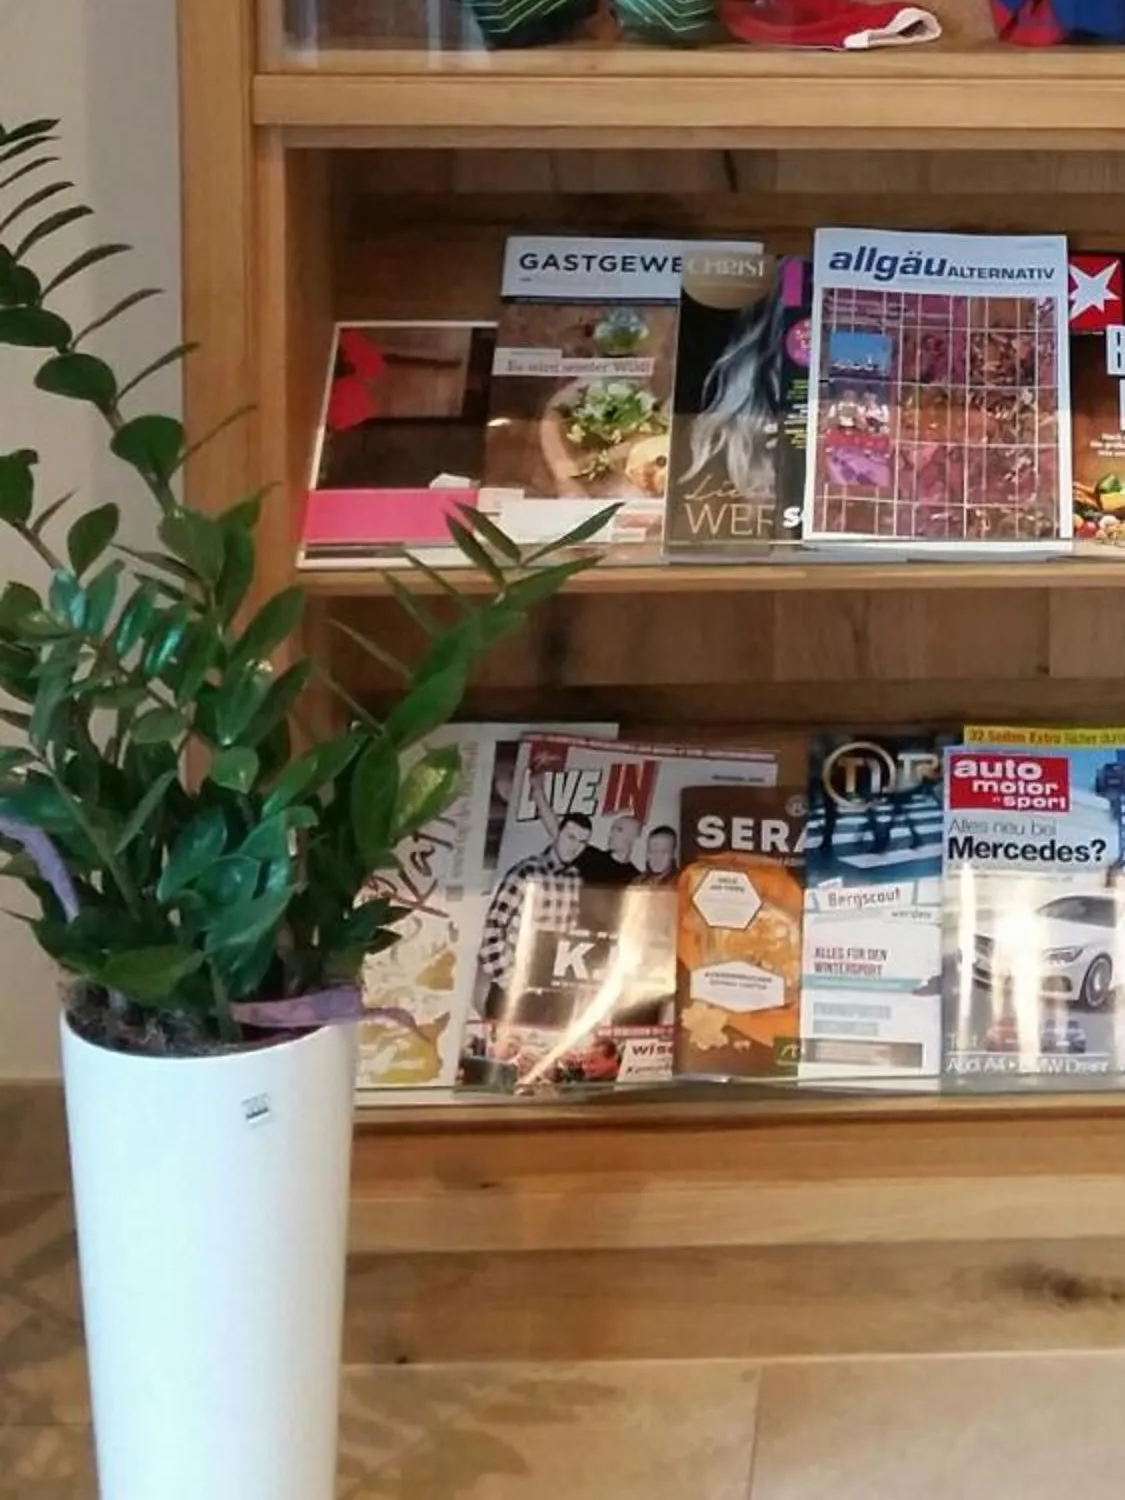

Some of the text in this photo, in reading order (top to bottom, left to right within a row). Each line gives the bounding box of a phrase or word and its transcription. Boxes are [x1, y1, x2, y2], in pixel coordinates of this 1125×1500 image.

[828, 245, 1055, 282] allgäu ALTERNATIV
[953, 758, 1044, 781] auto
[602, 758, 660, 818] IN
[972, 780, 1060, 794] motor
[1002, 794, 1067, 810] sport
[949, 817, 1058, 836] Alles neu bei
[947, 836, 1108, 863] Mercedes?
[827, 886, 902, 910] Bergscout
[814, 947, 846, 960] ALLES
[867, 948, 888, 962] DEN
